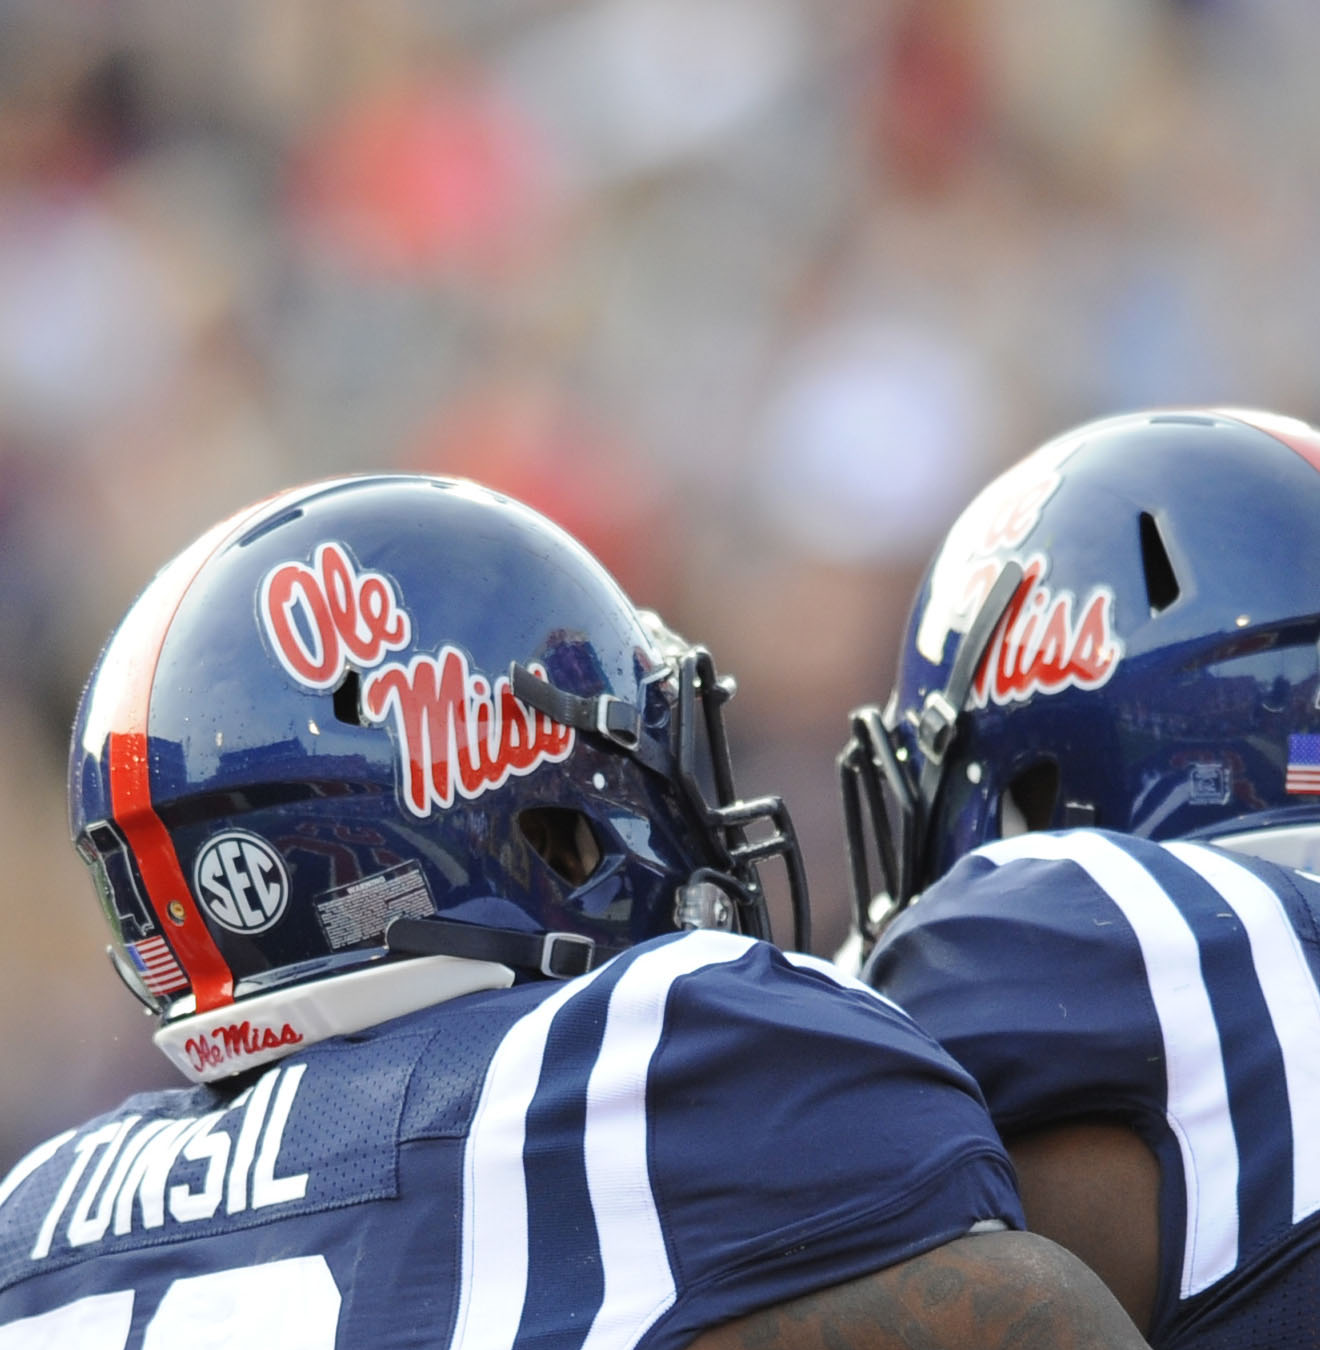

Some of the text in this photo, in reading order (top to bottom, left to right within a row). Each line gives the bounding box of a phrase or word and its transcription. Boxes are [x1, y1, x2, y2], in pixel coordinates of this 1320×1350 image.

[261, 543, 411, 689] Ole
[364, 646, 576, 817] Miss
[198, 835, 283, 928] SEC
[184, 1020, 304, 1073] Ole Miss
[30, 1062, 309, 1261] TUNSIL
